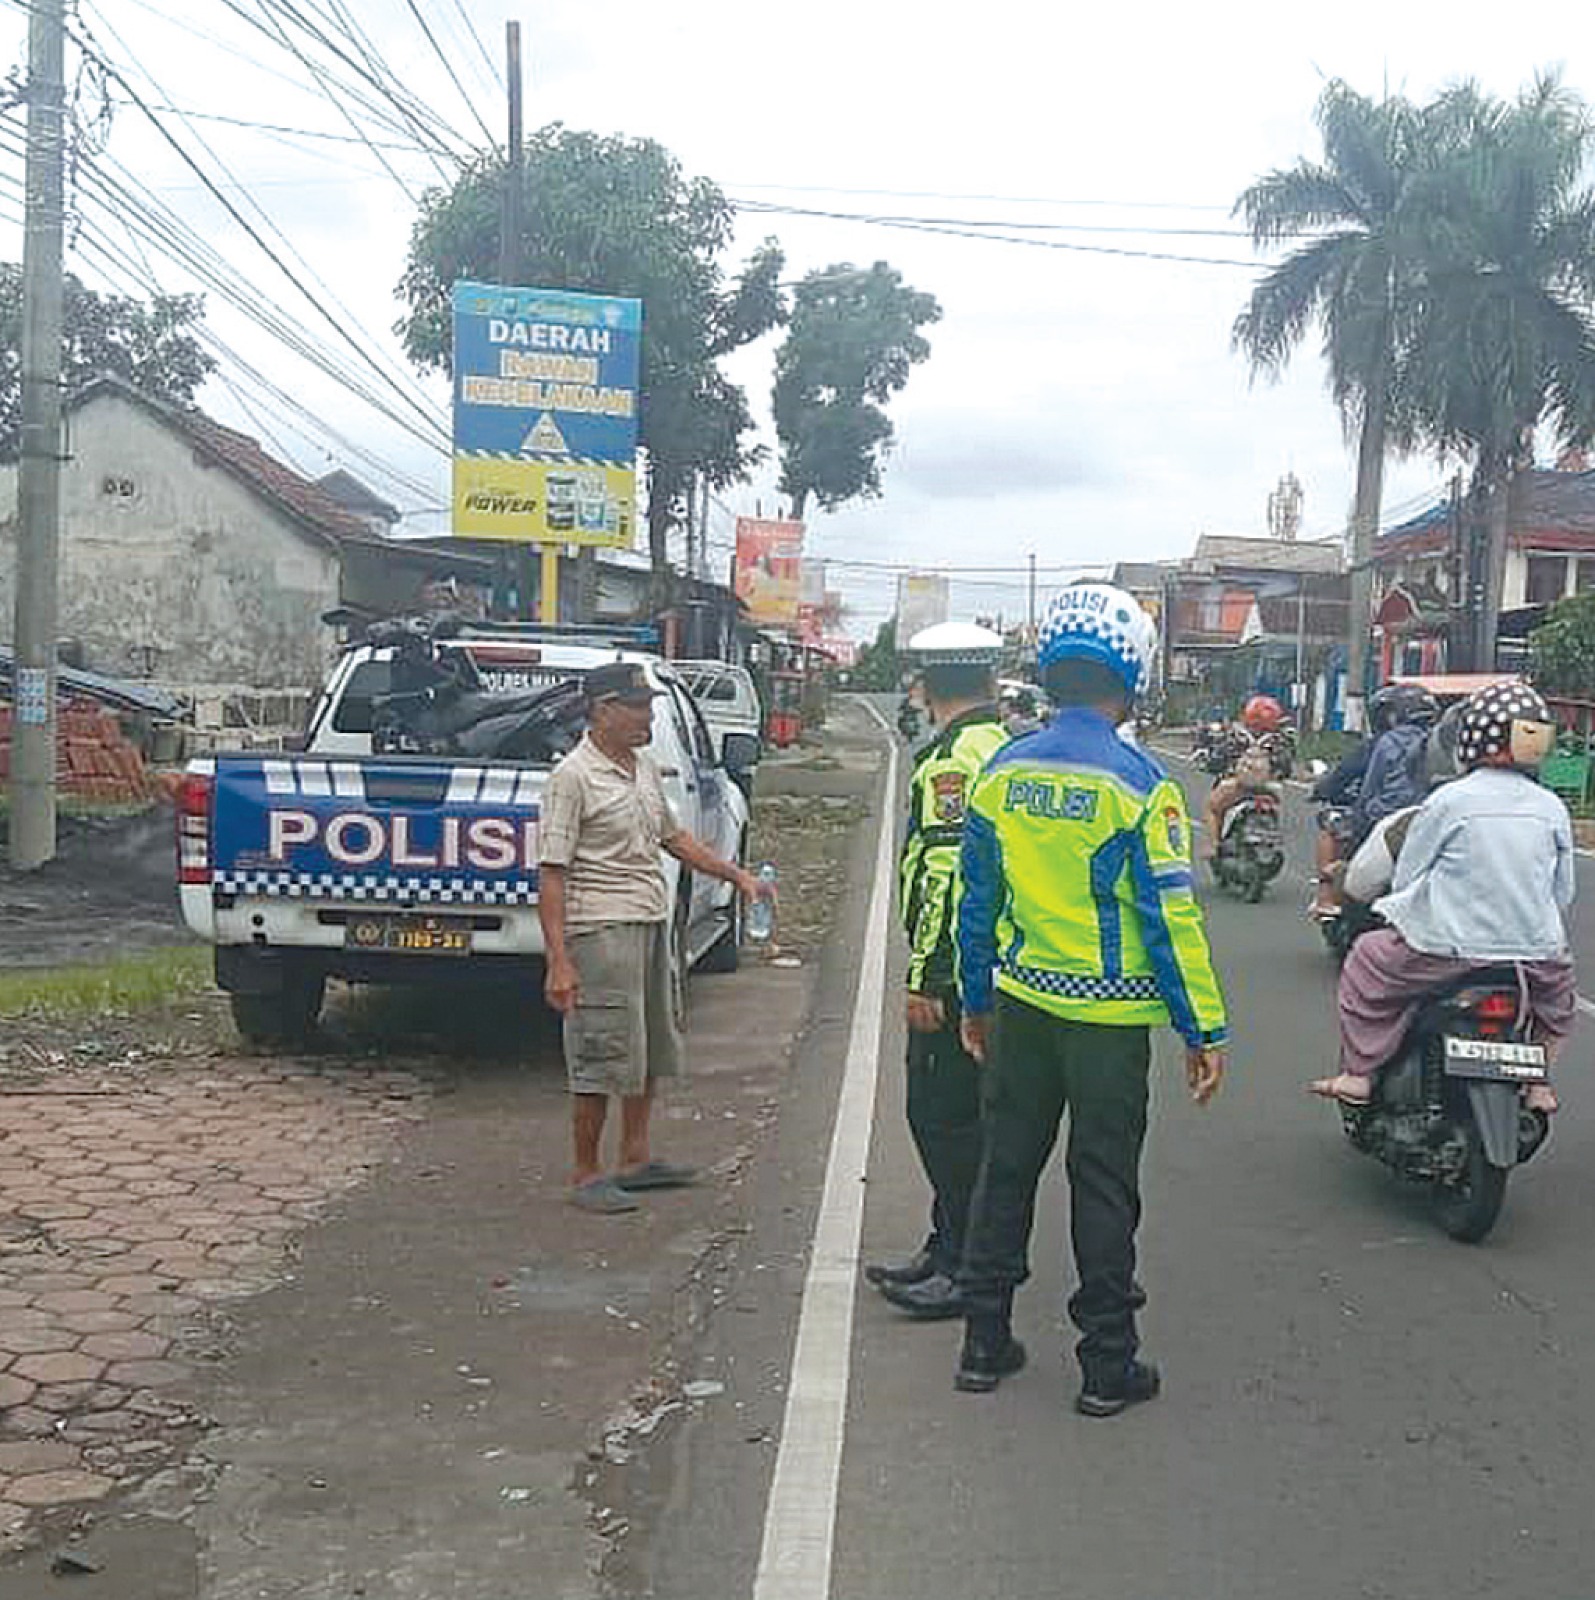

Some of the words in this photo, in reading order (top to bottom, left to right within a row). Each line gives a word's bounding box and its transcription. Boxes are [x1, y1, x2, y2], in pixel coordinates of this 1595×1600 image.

[489, 319, 610, 353] DAERAH
[1048, 590, 1109, 617] POLISI
[1005, 778, 1099, 822] POLISI
[269, 810, 542, 870] POLISI
